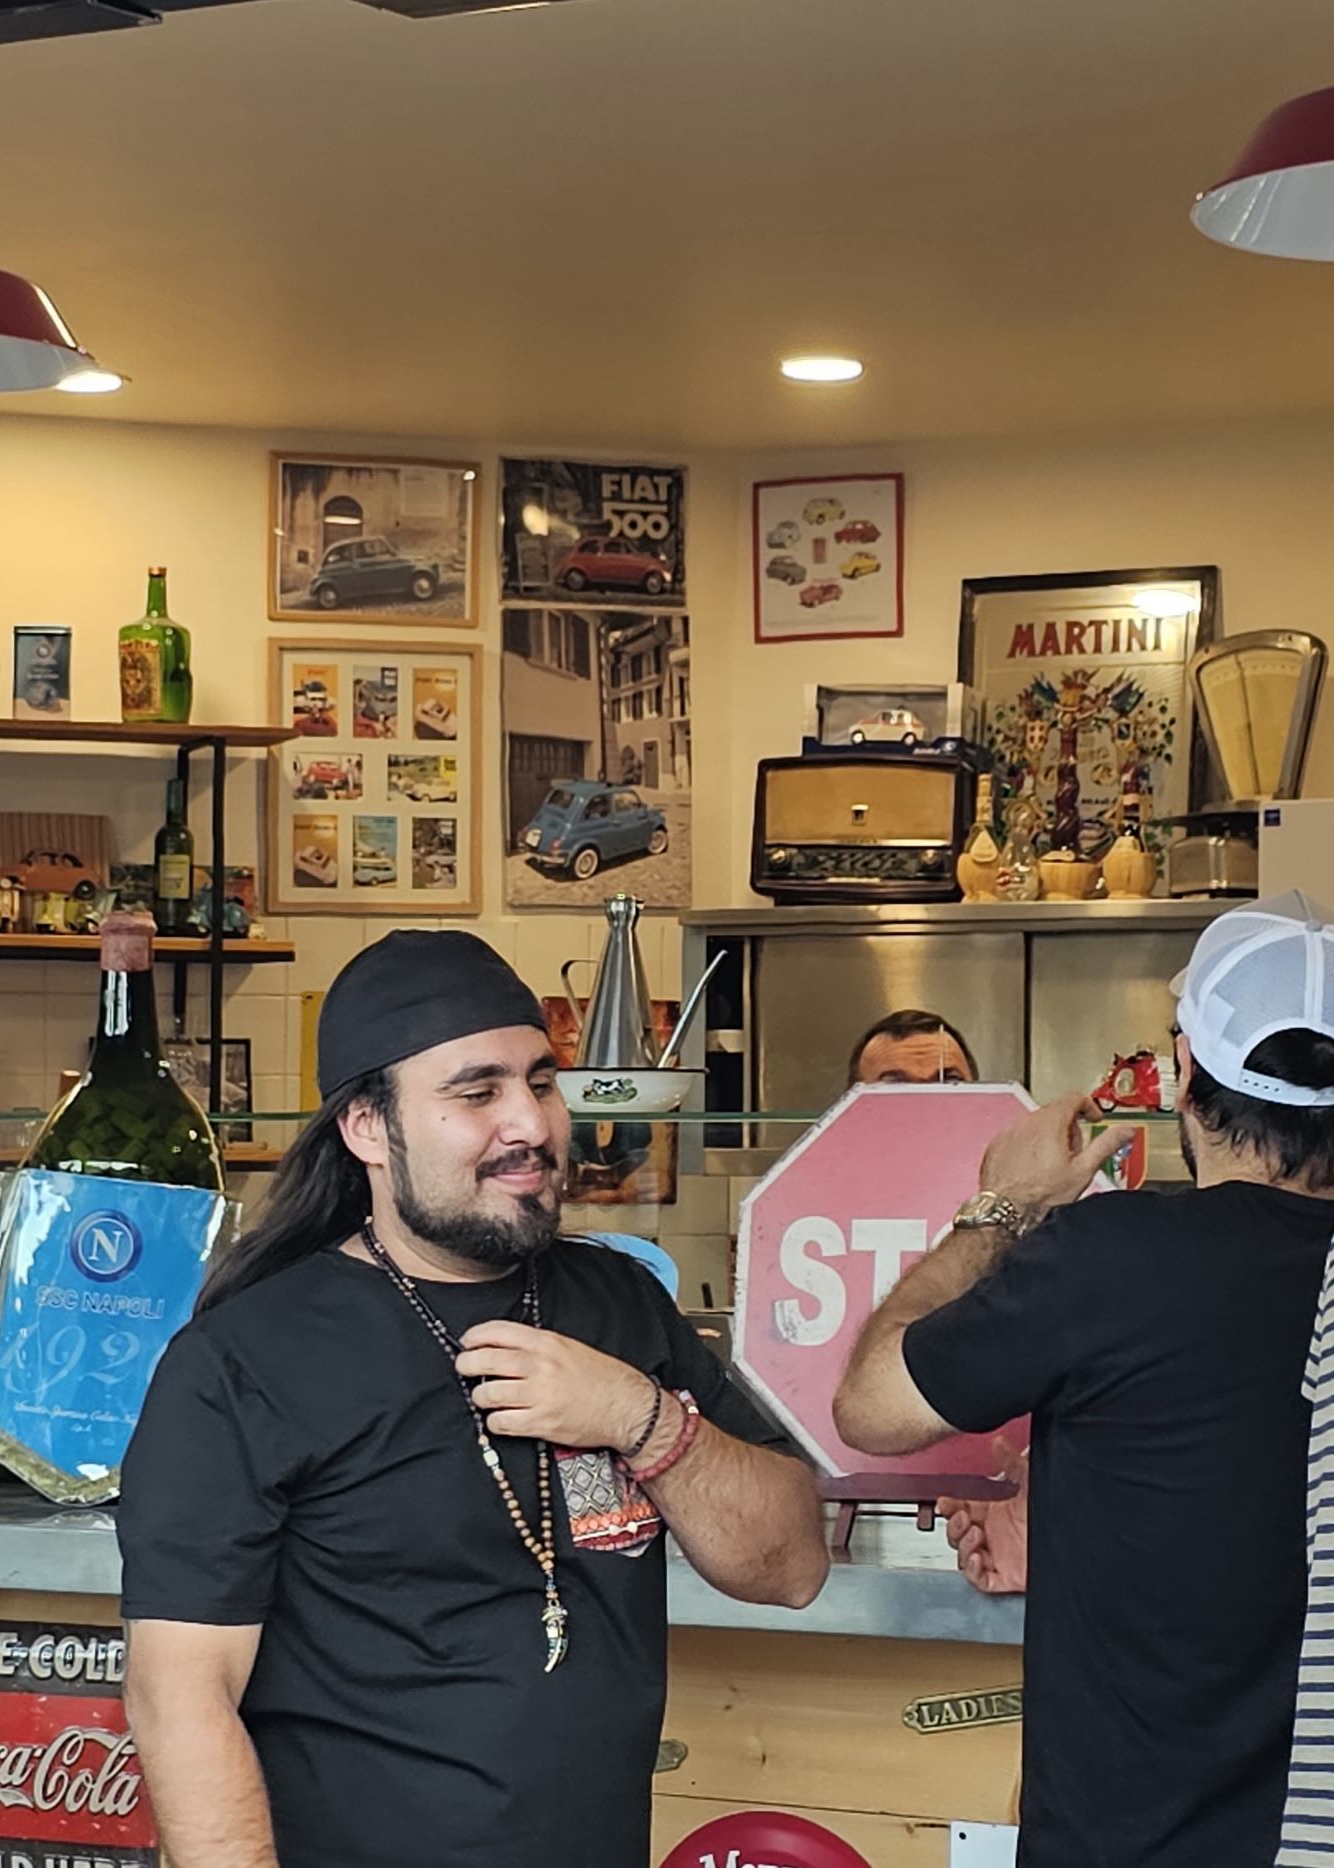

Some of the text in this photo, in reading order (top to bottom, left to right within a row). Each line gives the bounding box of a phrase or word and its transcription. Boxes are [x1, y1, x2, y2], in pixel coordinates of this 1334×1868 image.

[601, 473, 672, 501] FIAT
[602, 502, 669, 540] 500
[1006, 617, 1164, 660] MARTINI
[87, 1227, 124, 1264] N
[775, 1216, 954, 1346] ST
[36, 1285, 166, 1320] SSC NAPOLI
[28, 1634, 126, 1682] COLD
[920, 1692, 1023, 1727] LADIES
